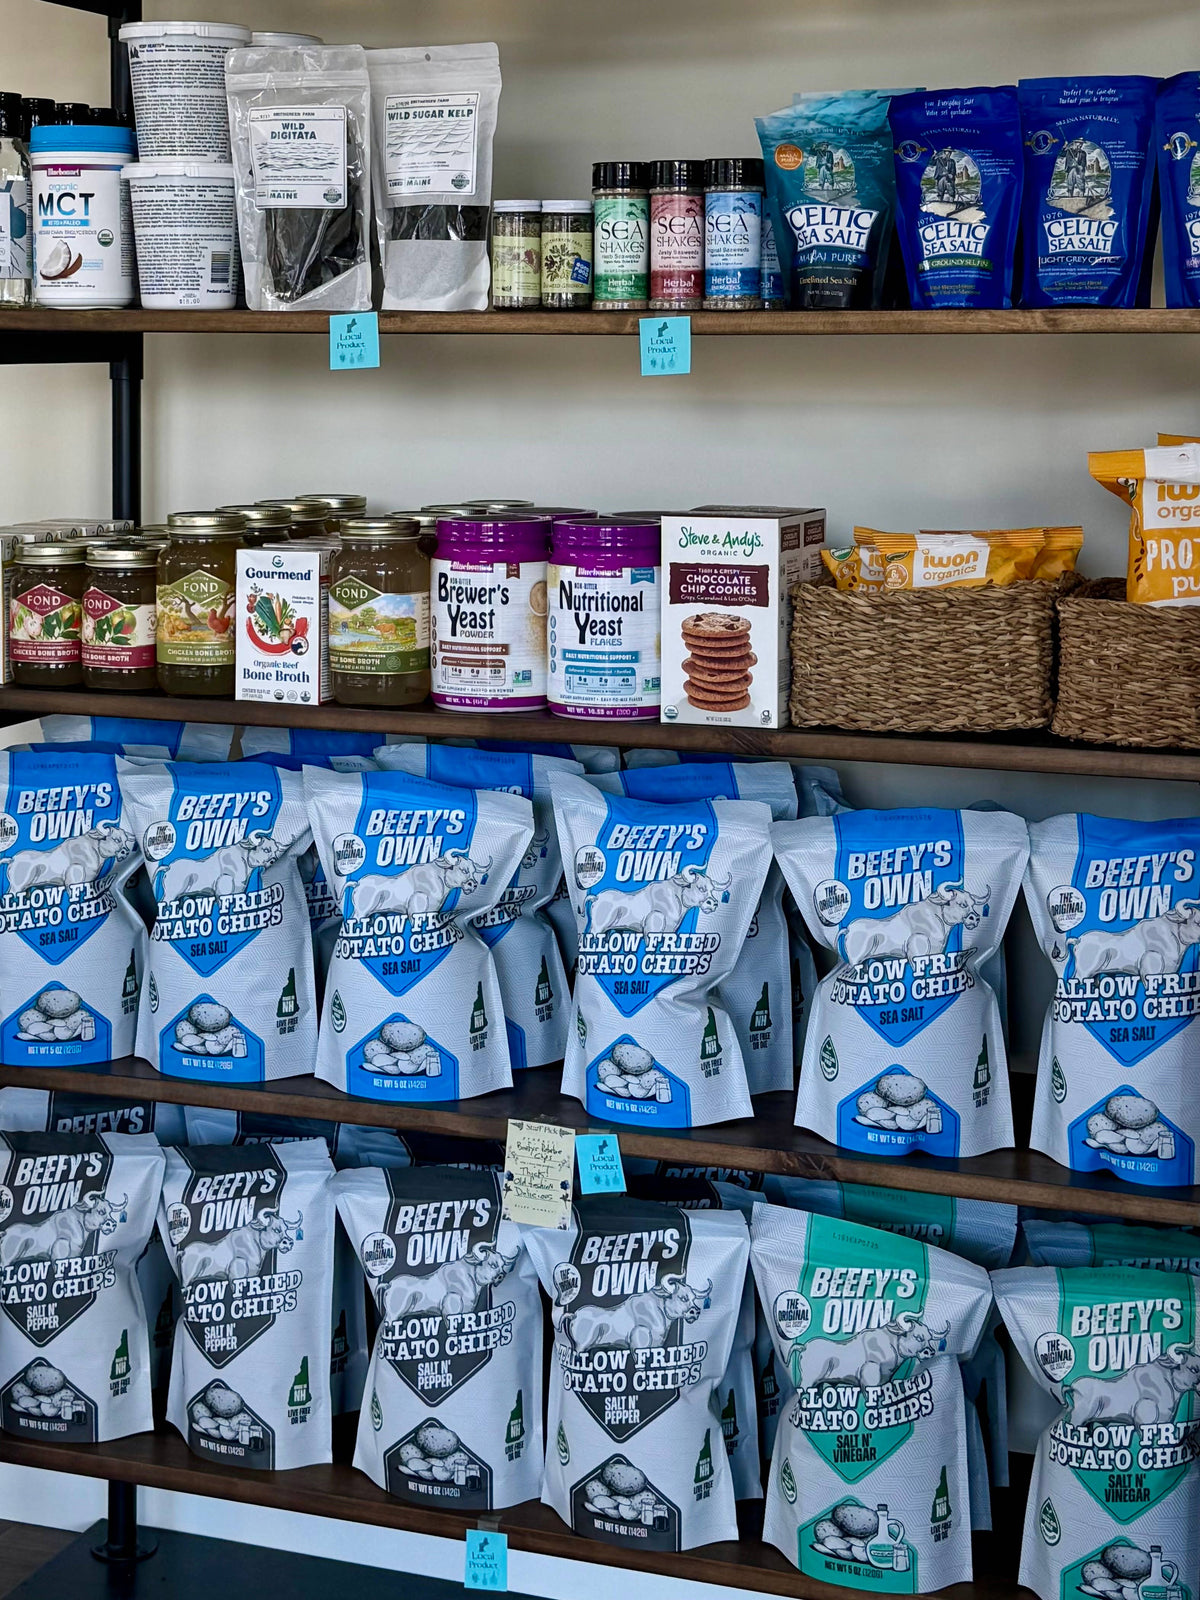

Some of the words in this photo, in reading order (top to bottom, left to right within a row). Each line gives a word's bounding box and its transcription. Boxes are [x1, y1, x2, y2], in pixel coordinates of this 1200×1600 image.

[386, 111, 410, 121] WILD
[412, 109, 444, 119] SUGAR
[447, 109, 473, 118] KELP
[281, 122, 305, 131] WILD
[270, 131, 317, 140] DIGITATA
[48, 182, 79, 192] organic
[38, 193, 95, 216] MCT
[707, 214, 748, 234] SEA
[789, 206, 873, 231] CELTIC
[917, 216, 935, 228] 1976
[1042, 211, 1063, 222] 1976
[601, 220, 644, 240] SEA
[657, 215, 701, 235] SEA
[922, 222, 987, 243] CELTIC
[1047, 220, 1115, 238] CELTIC
[657, 235, 702, 248] SHAKES
[707, 234, 750, 246] SHAKES
[798, 229, 819, 248] SEA
[1050, 238, 1077, 252] SEA
[600, 241, 645, 253] SHAKES
[925, 241, 947, 256] SEA
[1066, 255, 1087, 264] GREY
[608, 275, 635, 287] Herbal
[663, 275, 694, 287] Herbal
[711, 272, 741, 286] Herbal
[830, 277, 843, 285] Sea
[844, 276, 857, 286] Salt
[339, 332, 362, 341] Local
[650, 336, 674, 345] Local
[336, 342, 366, 350] Product
[647, 346, 677, 354] Product
[1157, 505, 1200, 521] orga
[678, 526, 711, 549] Steve
[711, 534, 721, 544] &
[700, 549, 738, 557] ORGANIC
[922, 549, 979, 568] iwon
[245, 567, 311, 581] Gourmend
[719, 567, 741, 575] CRISPY
[923, 564, 977, 582] organics
[686, 574, 751, 585] CHOCOLATE
[183, 583, 219, 593] FOND
[336, 587, 369, 599] FOND
[438, 572, 510, 606] Brewer's
[559, 580, 643, 612] Nutritional
[680, 584, 706, 594] CHIP
[708, 585, 758, 596] COOKIES
[27, 595, 61, 606] FOND
[84, 598, 111, 610] FOND
[447, 603, 496, 637] Yeast
[459, 630, 494, 639] POWDER
[574, 612, 624, 645] Yeast
[590, 638, 623, 647] FLAKES
[37, 649, 56, 657] BONE
[57, 649, 79, 657] BROTH
[90, 653, 106, 661] BONE
[107, 654, 130, 662] BROTH
[357, 657, 381, 665] BROTH
[610, 653, 632, 661] SUPPORT
[253, 660, 281, 670] Organic
[282, 660, 300, 669] Beef
[242, 668, 273, 681] Bone
[275, 670, 311, 683] Broth
[17, 782, 112, 814] BEEFY'S
[177, 791, 273, 821] BEEFY'S
[29, 808, 93, 842] OWN
[365, 804, 467, 836] BEEFY'S
[185, 818, 249, 851] OWN
[606, 823, 709, 850] BEEFY'S
[376, 836, 443, 868] OWN
[583, 852, 597, 863] THE
[847, 839, 952, 880] BEEFY'S
[615, 850, 681, 882] OWN
[1085, 848, 1195, 888] BEEFY'S
[219, 883, 285, 914] FRIED
[864, 878, 932, 910] OWN
[1059, 892, 1073, 904] THE
[1051, 902, 1084, 917] ORIGINAL
[1098, 884, 1171, 921] OWN
[217, 903, 283, 936] CHIPS
[645, 931, 720, 955] FRIED
[641, 953, 712, 976] CHIPS
[614, 981, 629, 995] SEA
[630, 981, 649, 995] SALT
[879, 1009, 900, 1026] SEA
[901, 1006, 924, 1024] SALT
[1110, 1026, 1130, 1043] SEA
[1132, 1025, 1155, 1042] SALT
[591, 1154, 615, 1163] Local
[14, 1152, 104, 1187] BEEFY'S
[589, 1163, 619, 1171] Product
[190, 1168, 278, 1205] BEEFY'S
[21, 1179, 83, 1216] OWN
[199, 1197, 257, 1234] OWN
[394, 1198, 492, 1235] BEEFY'S
[372, 1238, 386, 1250] THE
[406, 1230, 470, 1267] OWN
[580, 1228, 680, 1264] BEEFY'S
[364, 1247, 395, 1262] ORIGINAL
[591, 1260, 659, 1297] OWN
[809, 1266, 918, 1299] BEEFY'S
[26, 1315, 60, 1332] PEPPER
[446, 1301, 517, 1336] FRIED
[822, 1299, 895, 1335] OWN
[1071, 1298, 1185, 1338] BEEFY'S
[204, 1336, 238, 1352] PEPPER
[635, 1336, 709, 1368] FRIED
[1087, 1333, 1163, 1374] OWN
[417, 1373, 454, 1391] PEPPER
[832, 1446, 878, 1465] VINEGAR
[1104, 1487, 1151, 1503] VINEGAR
[471, 1551, 495, 1561] Local
[469, 1560, 499, 1569] Product
